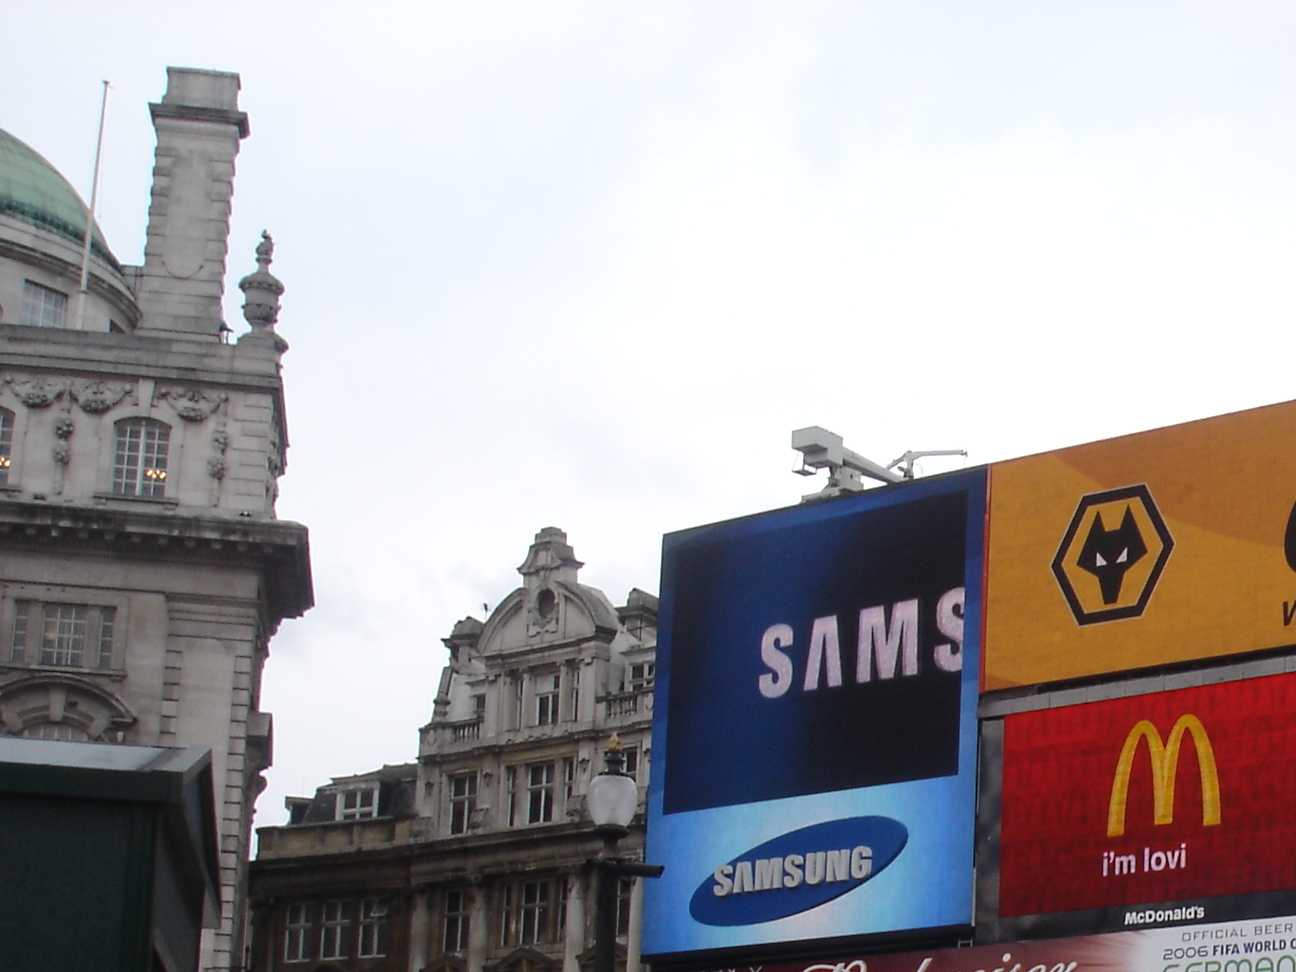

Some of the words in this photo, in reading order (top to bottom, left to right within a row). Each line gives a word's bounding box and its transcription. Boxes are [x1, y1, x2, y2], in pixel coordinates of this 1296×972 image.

[713, 845, 873, 897] SAMSUNG
[1102, 851, 1136, 877] i'm
[1144, 843, 1187, 872] lovi
[1124, 905, 1205, 926] McDonald's
[1181, 929, 1248, 942] OFFICIAL
[1254, 923, 1293, 936] BEER
[1163, 945, 1209, 961] 2006
[1212, 944, 1240, 957] FIFA
[1243, 938, 1287, 954] WORLD
